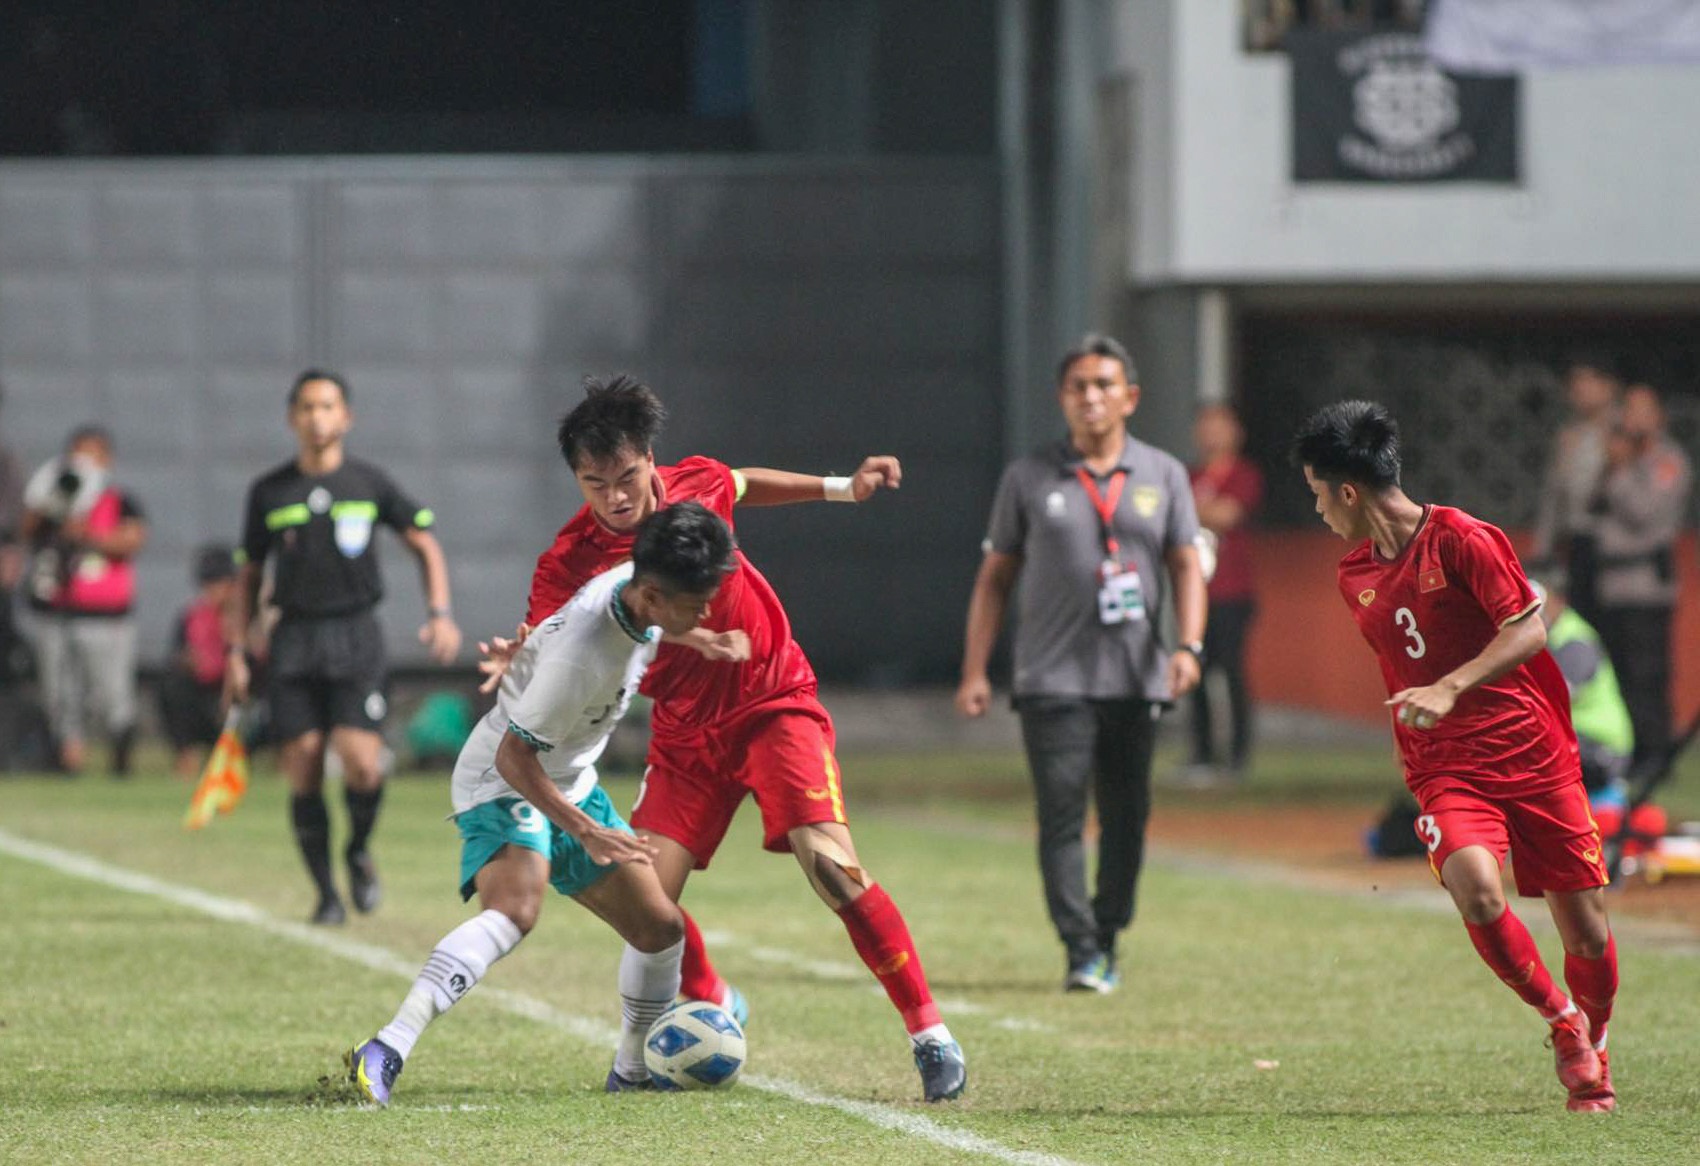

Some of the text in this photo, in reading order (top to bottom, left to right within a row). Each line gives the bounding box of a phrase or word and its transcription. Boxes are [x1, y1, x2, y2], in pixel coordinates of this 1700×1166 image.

[1395, 607, 1426, 659] 3
[509, 800, 544, 833] 9
[1418, 815, 1442, 852] 3
